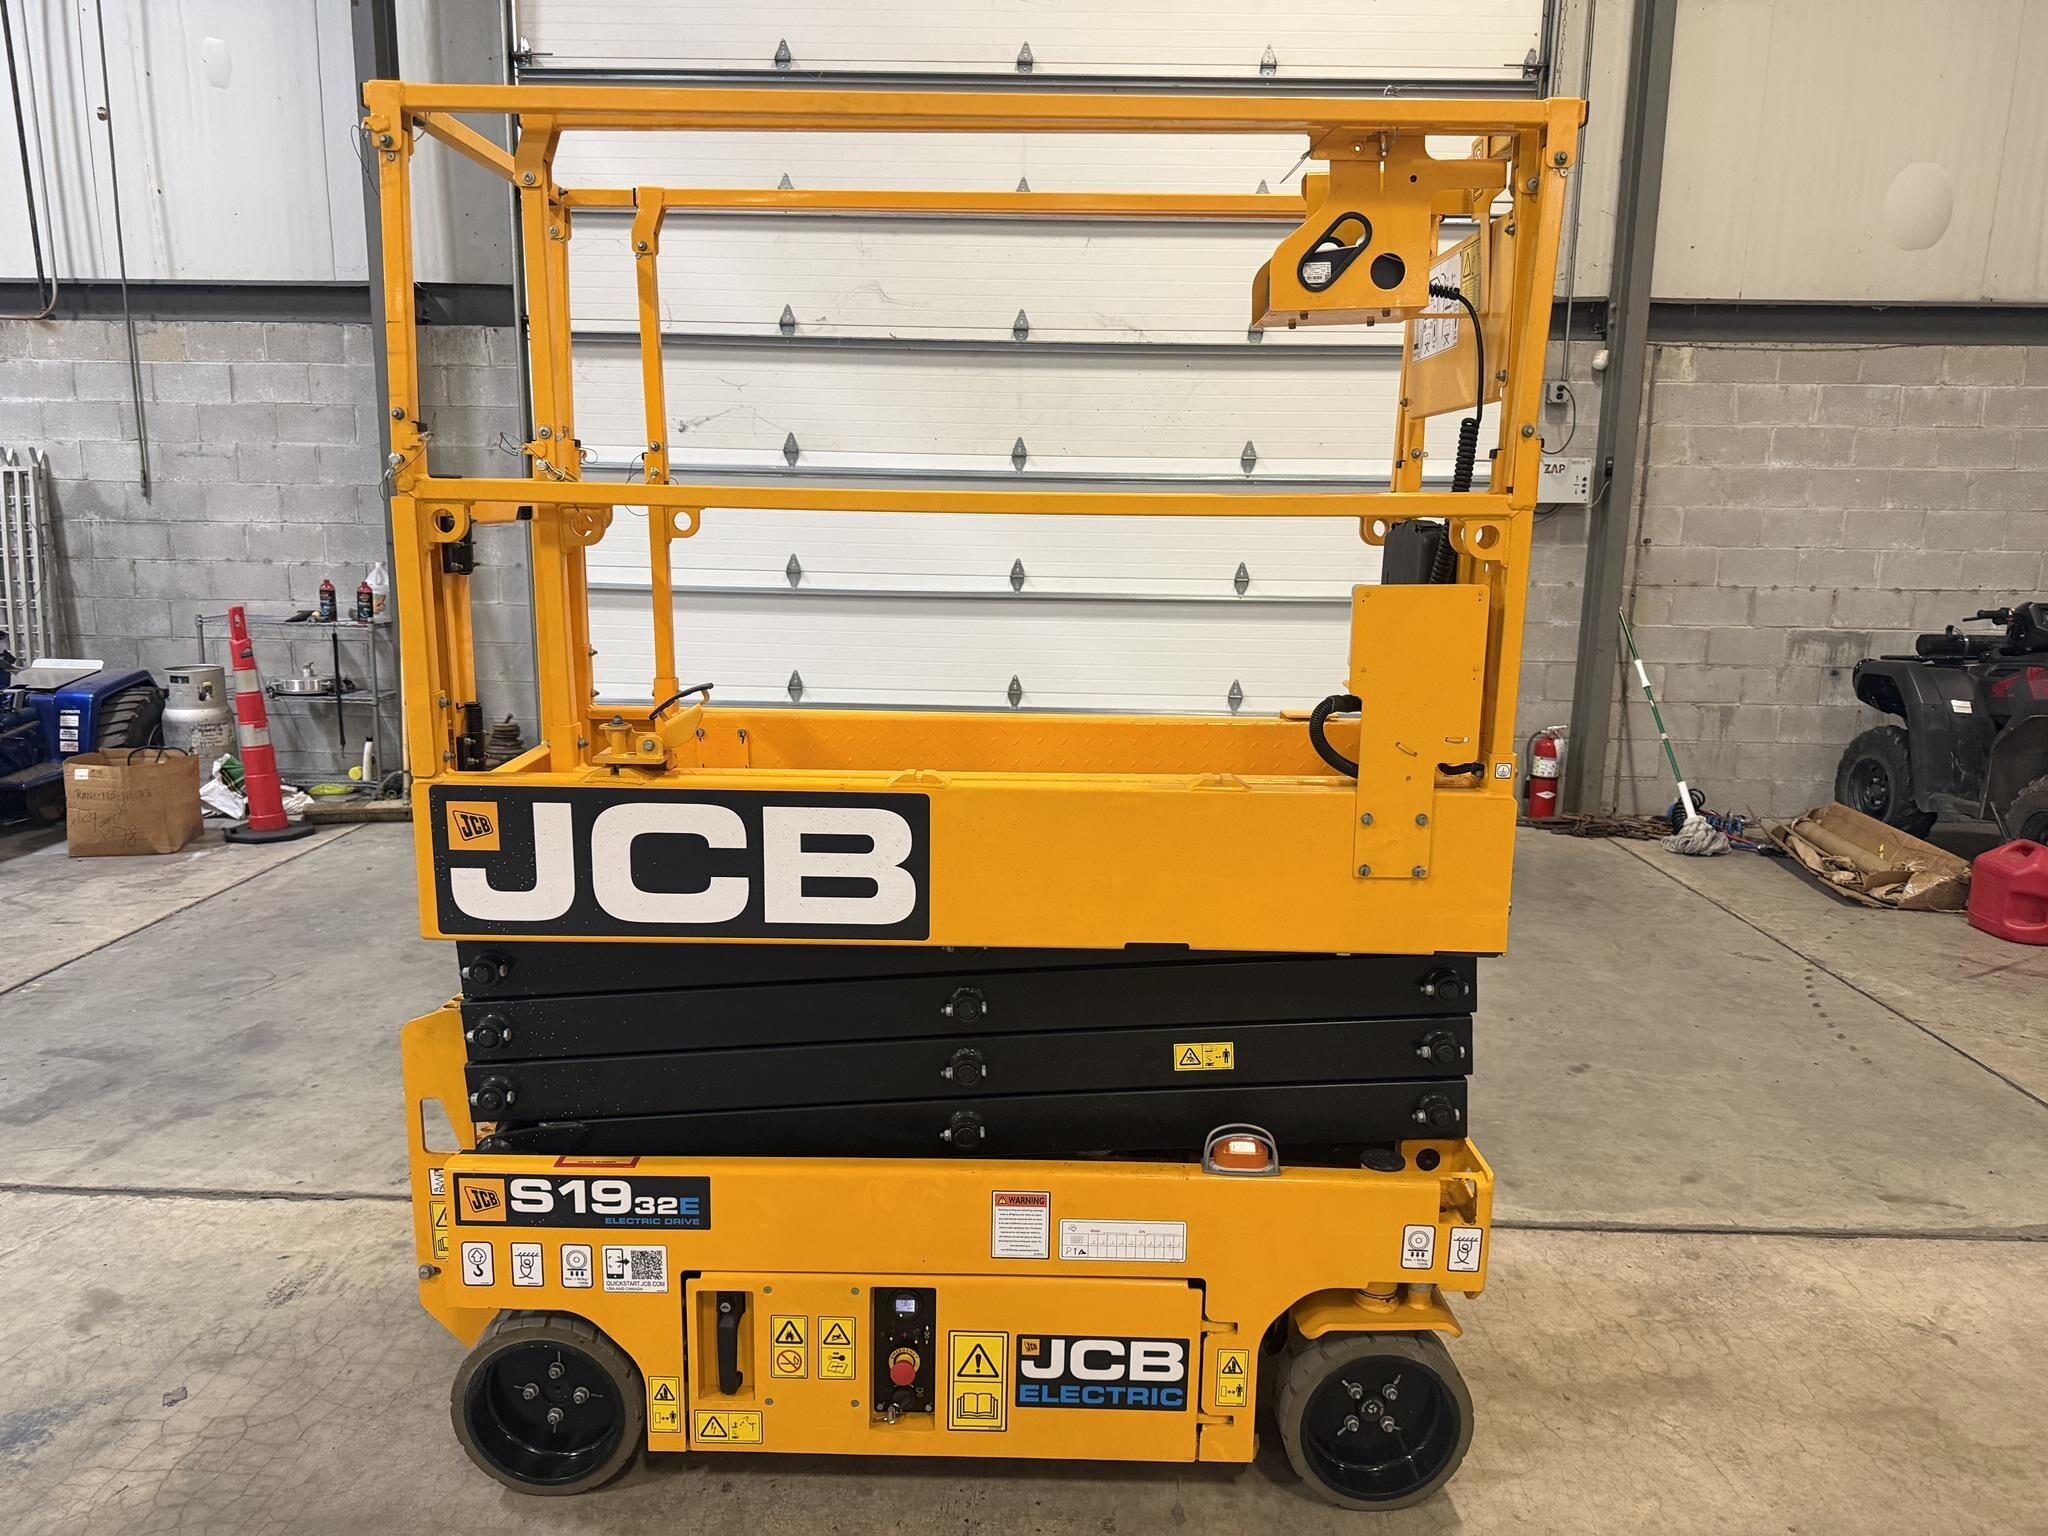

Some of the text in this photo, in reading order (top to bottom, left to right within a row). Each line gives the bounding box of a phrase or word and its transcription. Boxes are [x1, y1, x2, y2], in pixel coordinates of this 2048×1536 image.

[1543, 463, 1566, 474] ZAP
[460, 814, 491, 838] JCB
[450, 802, 917, 925] JCB
[471, 1189, 498, 1208] JCB
[1008, 1196, 1045, 1205] WARNING
[605, 1217, 700, 1226] ELECTRIC DRIVE
[1021, 1339, 1185, 1382] JCB
[1019, 1384, 1185, 1407] ELECTRIC
